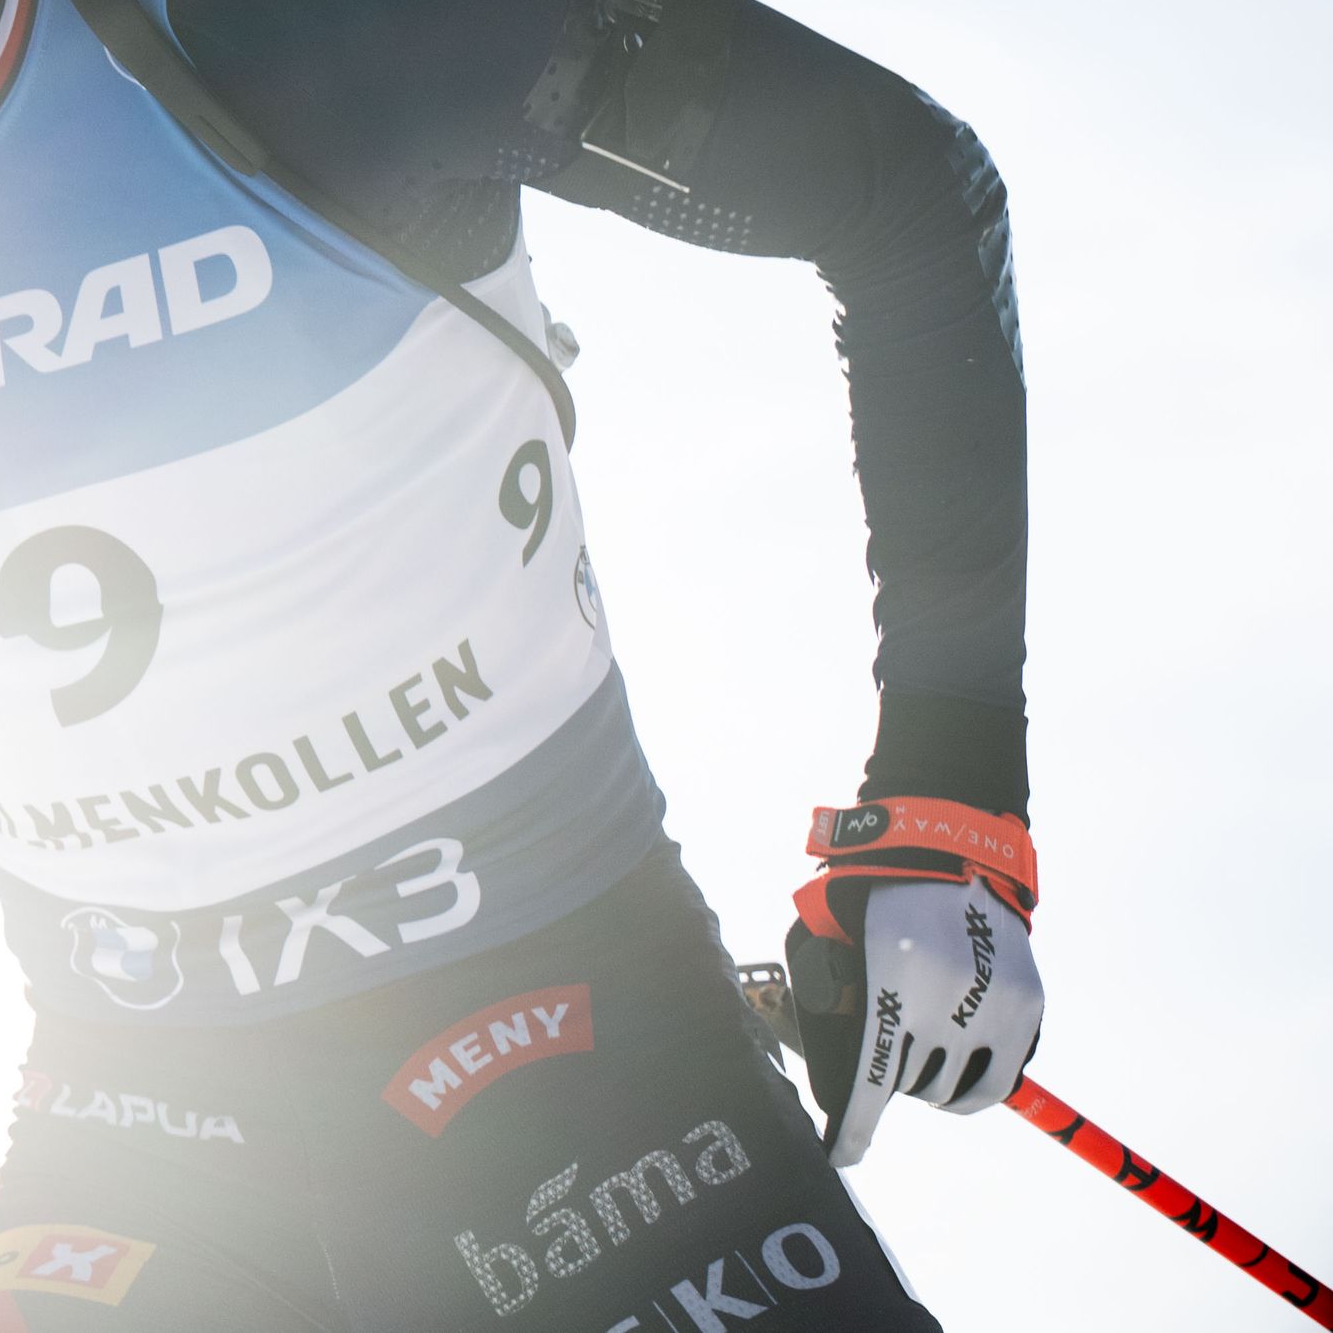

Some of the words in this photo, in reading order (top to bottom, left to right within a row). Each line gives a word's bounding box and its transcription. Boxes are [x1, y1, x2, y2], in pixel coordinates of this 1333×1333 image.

[498, 438, 553, 568] 9
[951, 902, 998, 1028] KINETIXX
[407, 1002, 570, 1112] MENY
[867, 987, 903, 1086] KINETIXX
[50, 1084, 245, 1144] LAPUA
